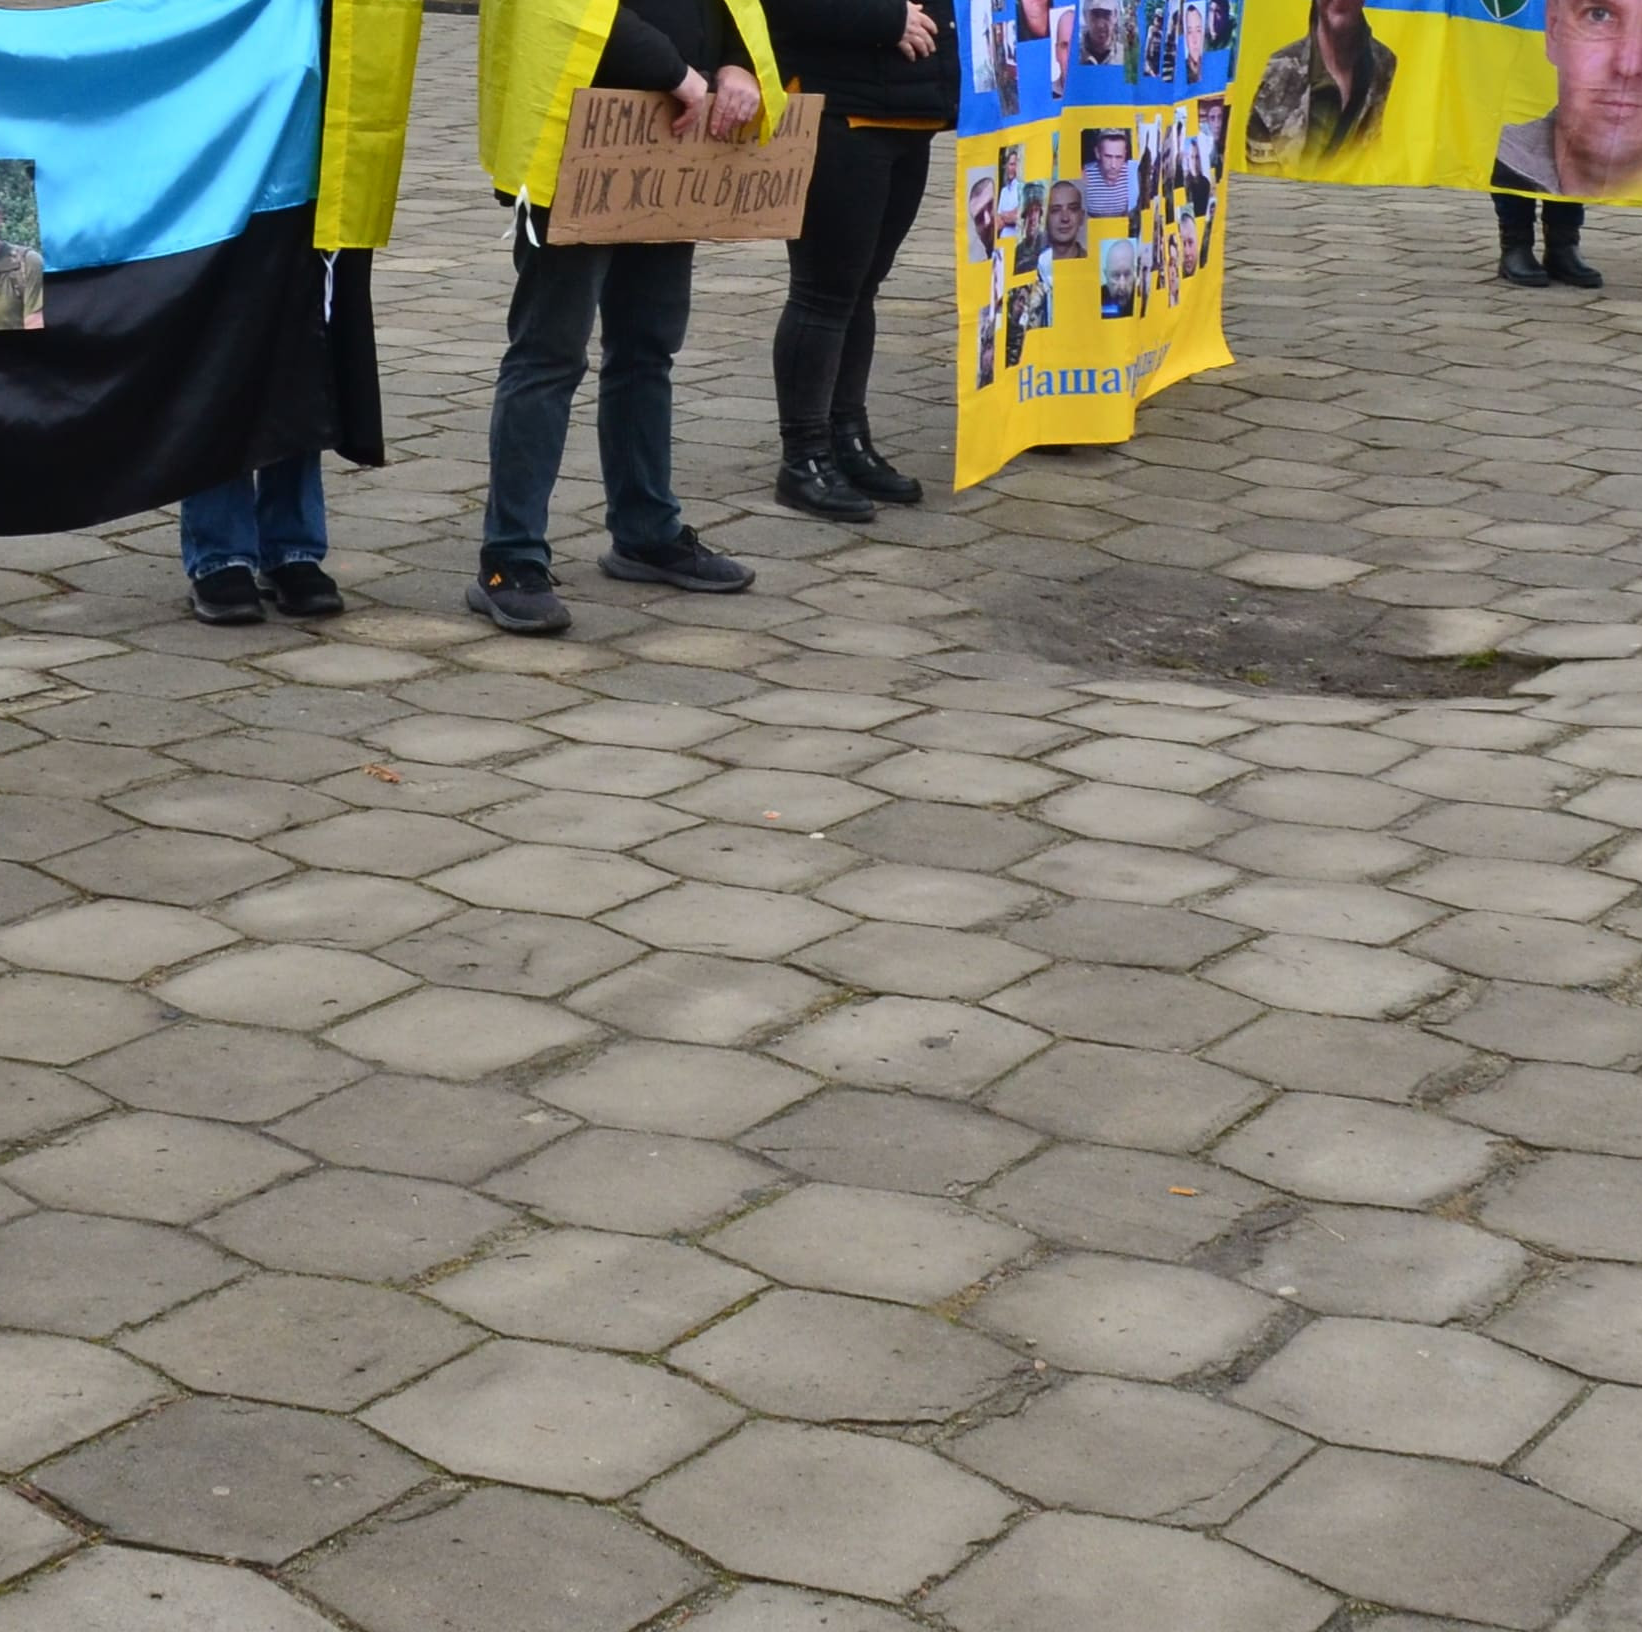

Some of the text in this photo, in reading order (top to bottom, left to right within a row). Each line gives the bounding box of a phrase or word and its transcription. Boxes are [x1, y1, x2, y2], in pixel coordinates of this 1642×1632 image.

[582, 97, 664, 148] НЕМАЄ
[713, 165, 732, 208] В
[1018, 364, 1122, 403] Наша
